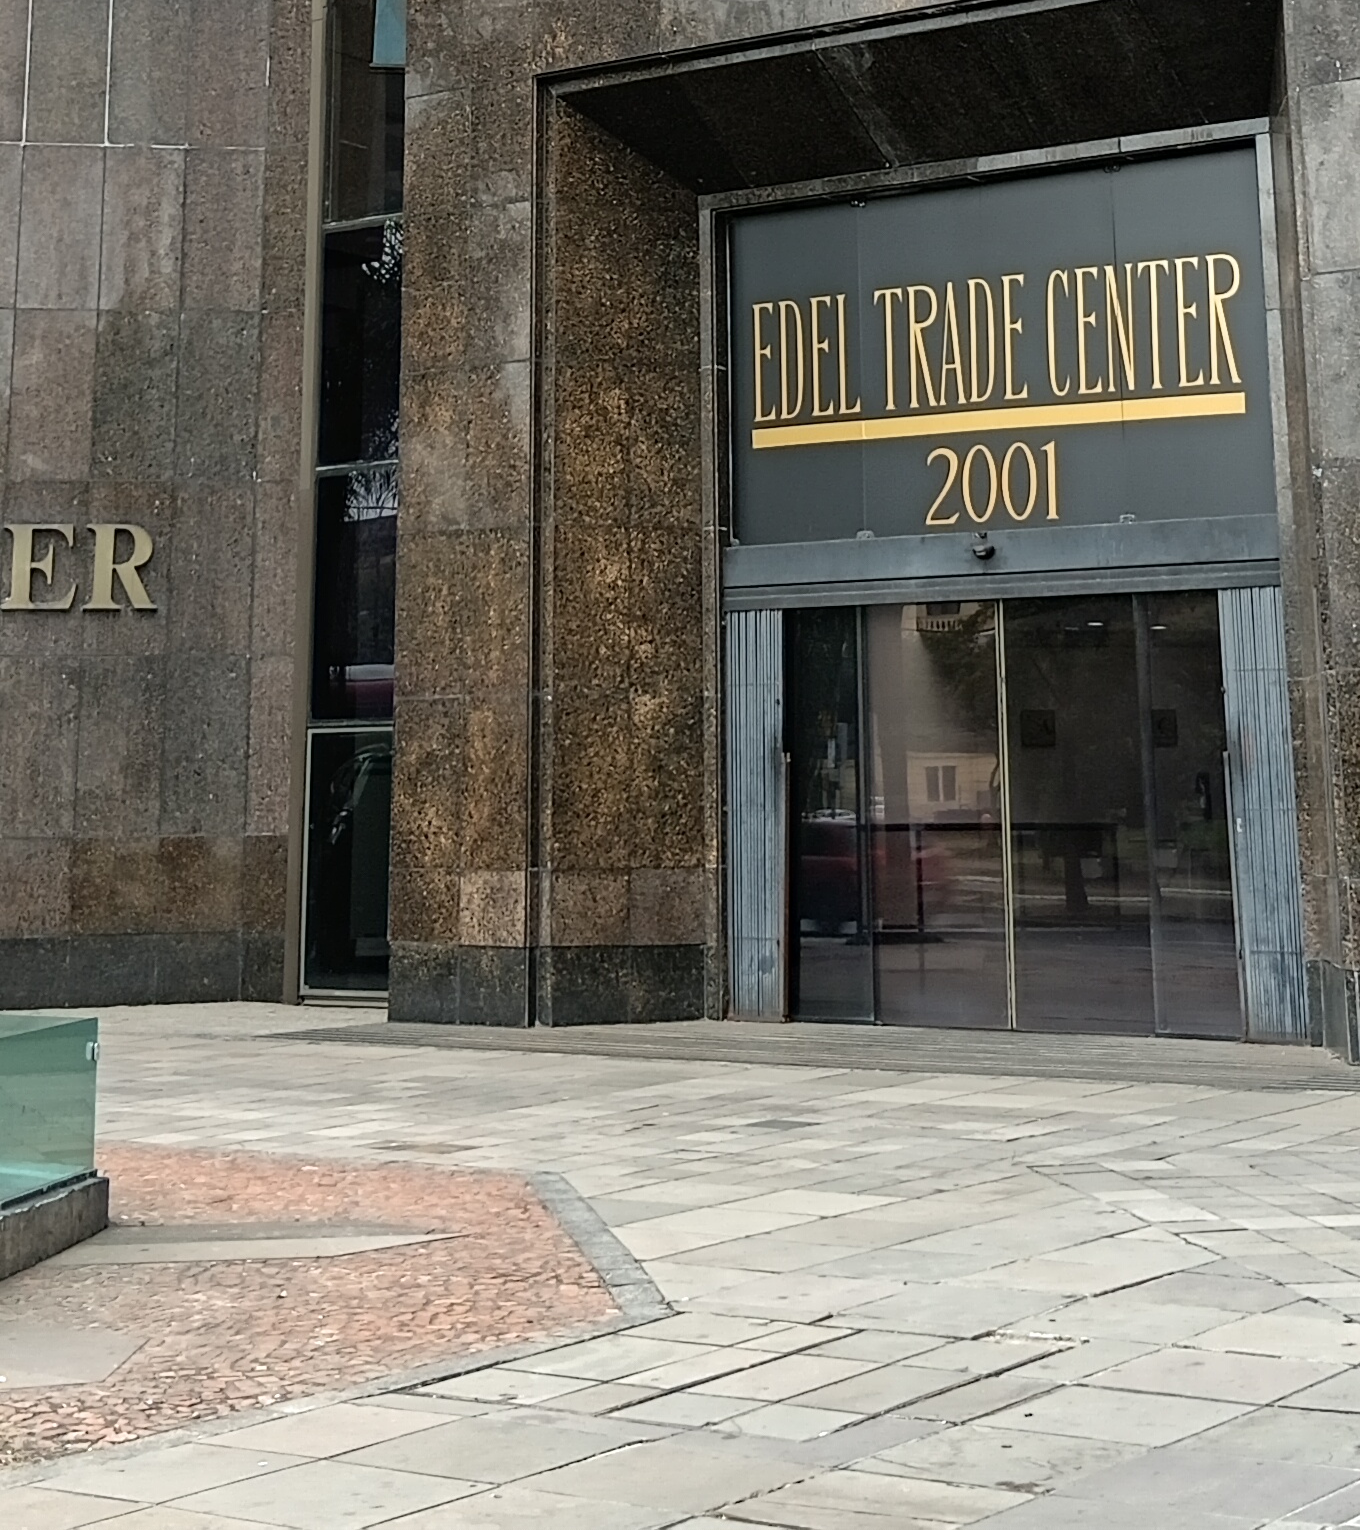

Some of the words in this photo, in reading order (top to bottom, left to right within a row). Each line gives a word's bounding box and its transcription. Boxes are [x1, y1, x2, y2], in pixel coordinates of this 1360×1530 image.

[752, 293, 861, 422] EDEL
[873, 274, 1028, 411] TRADE
[1047, 253, 1242, 397] CENTER
[925, 440, 1060, 526] 2001
